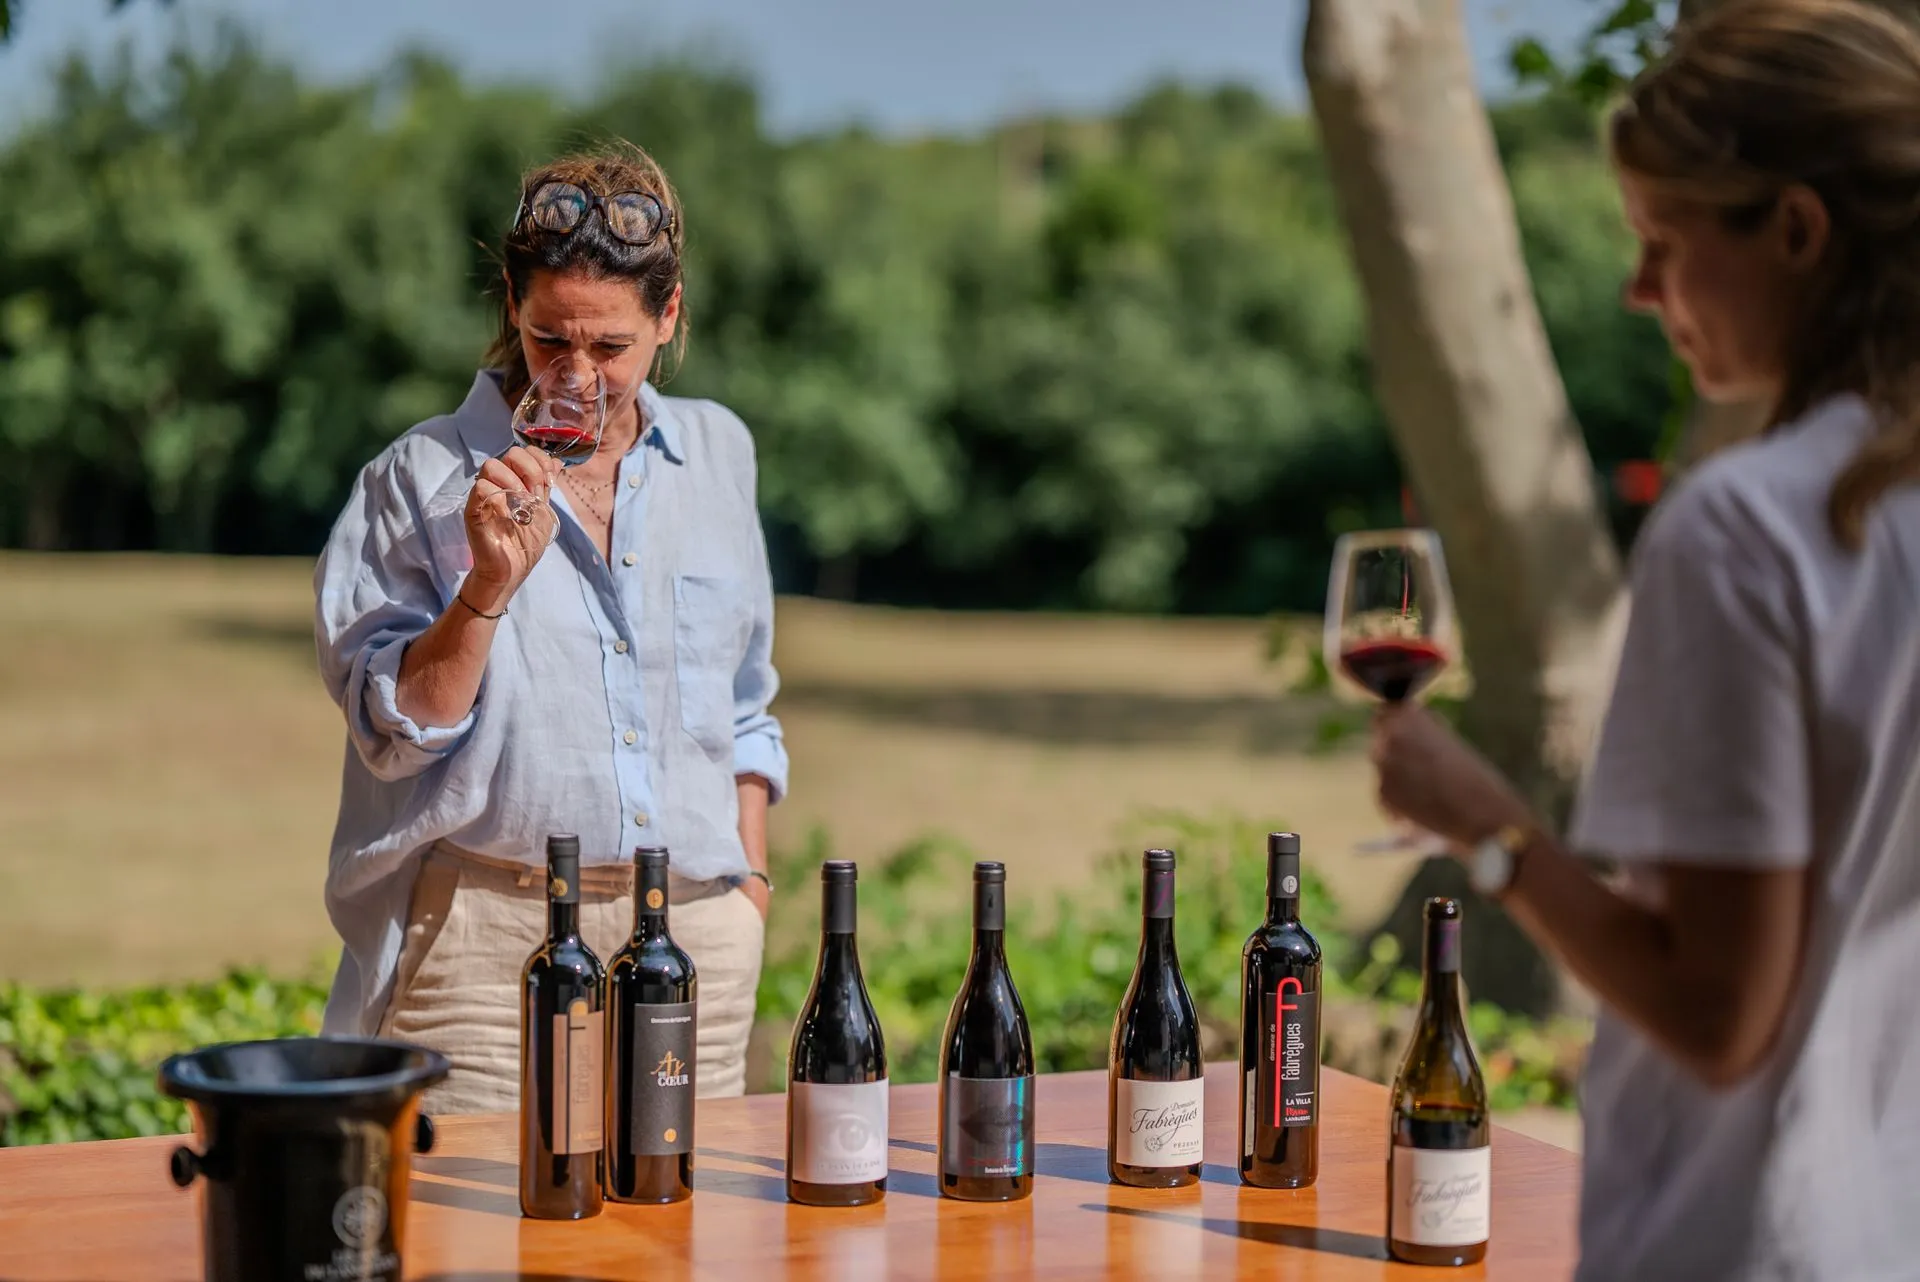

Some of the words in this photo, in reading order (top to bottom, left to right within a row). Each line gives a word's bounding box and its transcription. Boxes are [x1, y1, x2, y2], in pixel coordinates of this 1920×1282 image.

[1281, 1023, 1305, 1080] fabrègues
[1286, 1098, 1295, 1106] LA
[1129, 1107, 1198, 1142] Fabrègues
